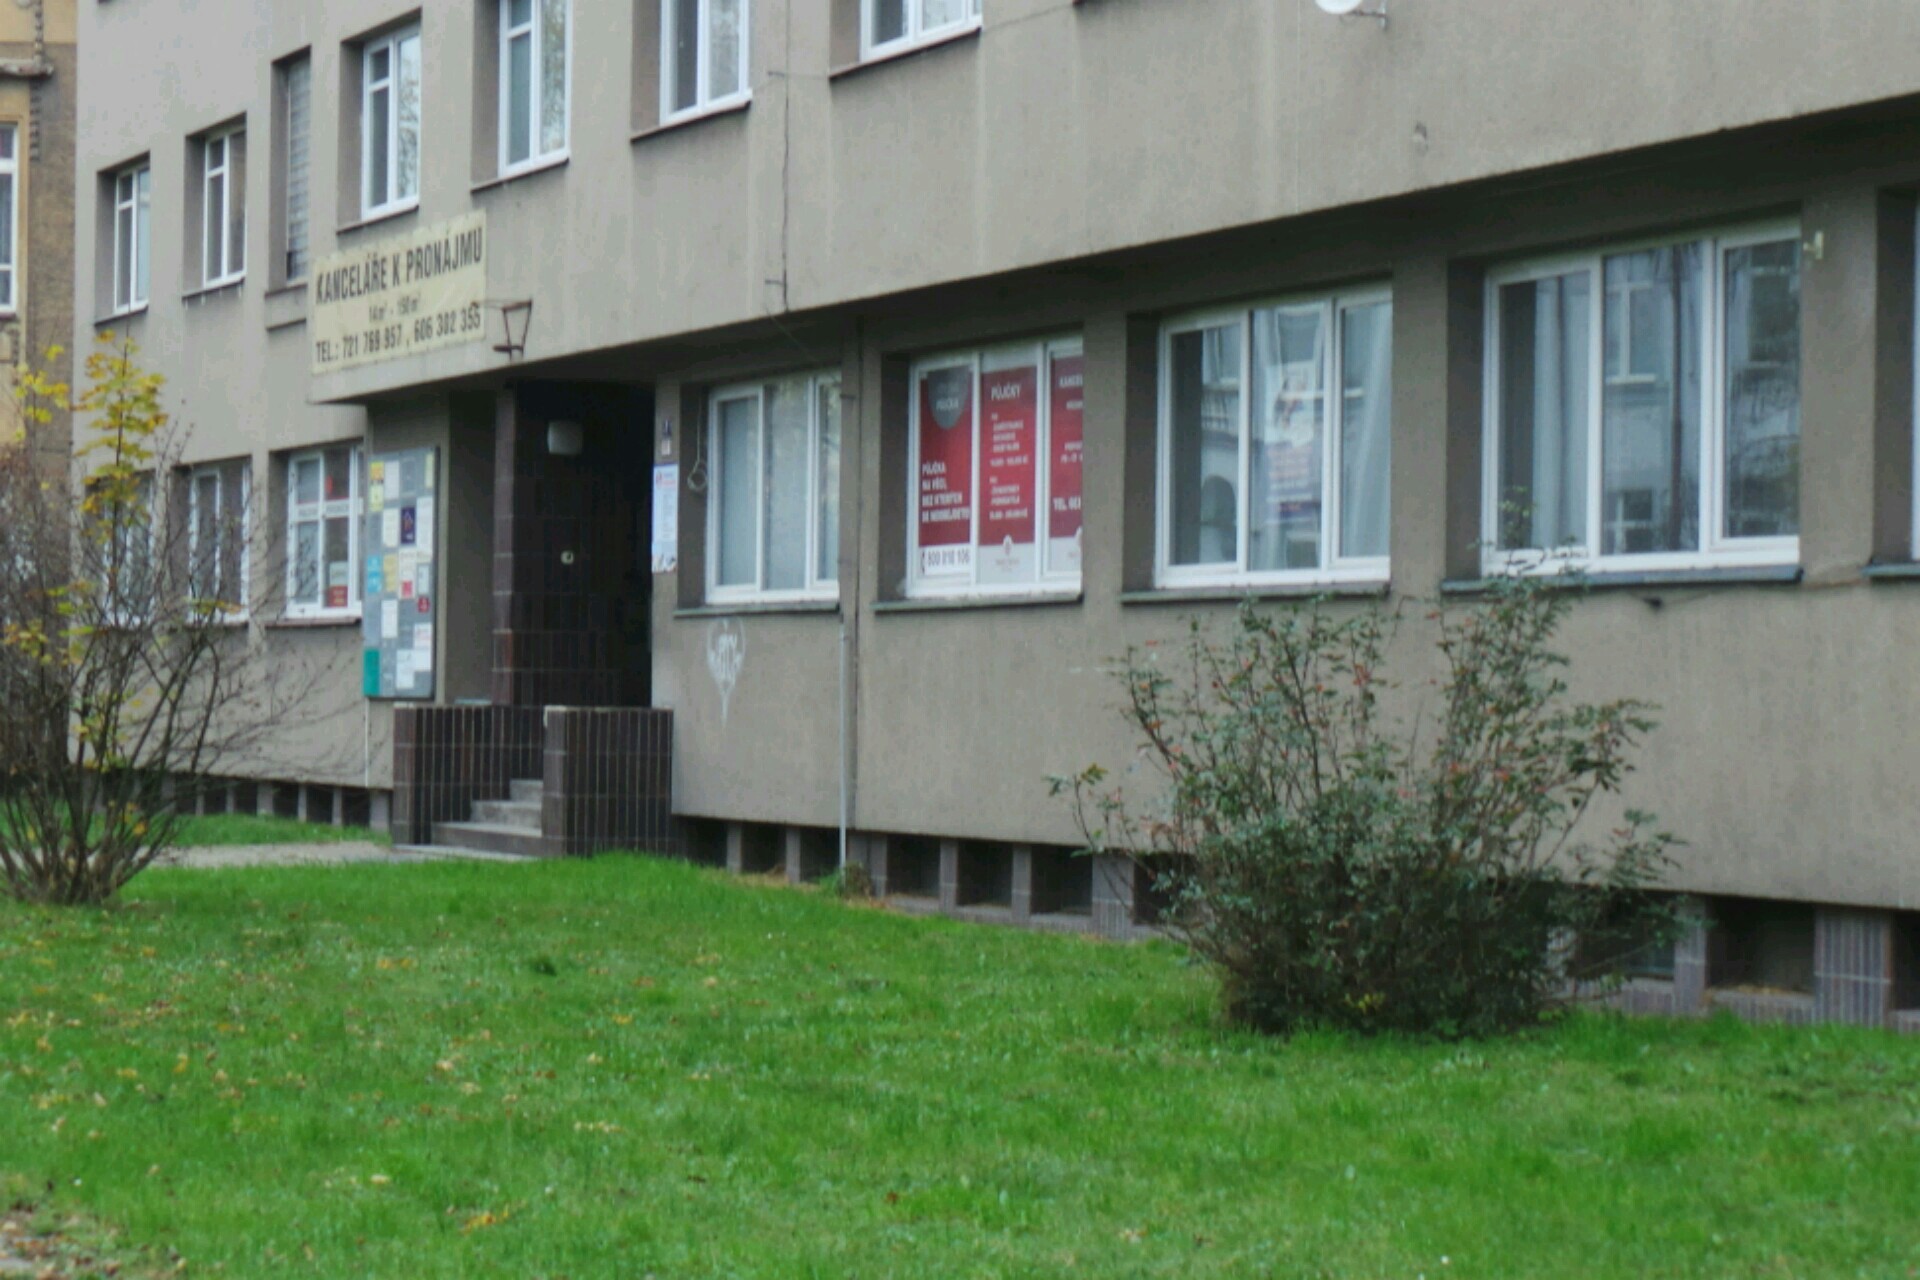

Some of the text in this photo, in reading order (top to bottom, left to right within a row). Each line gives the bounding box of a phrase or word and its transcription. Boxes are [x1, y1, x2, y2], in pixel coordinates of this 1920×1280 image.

[316, 228, 482, 304] KANCELÁŘE K PRONÁJMU
[342, 334, 358, 359] 721
[414, 316, 433, 342] 606
